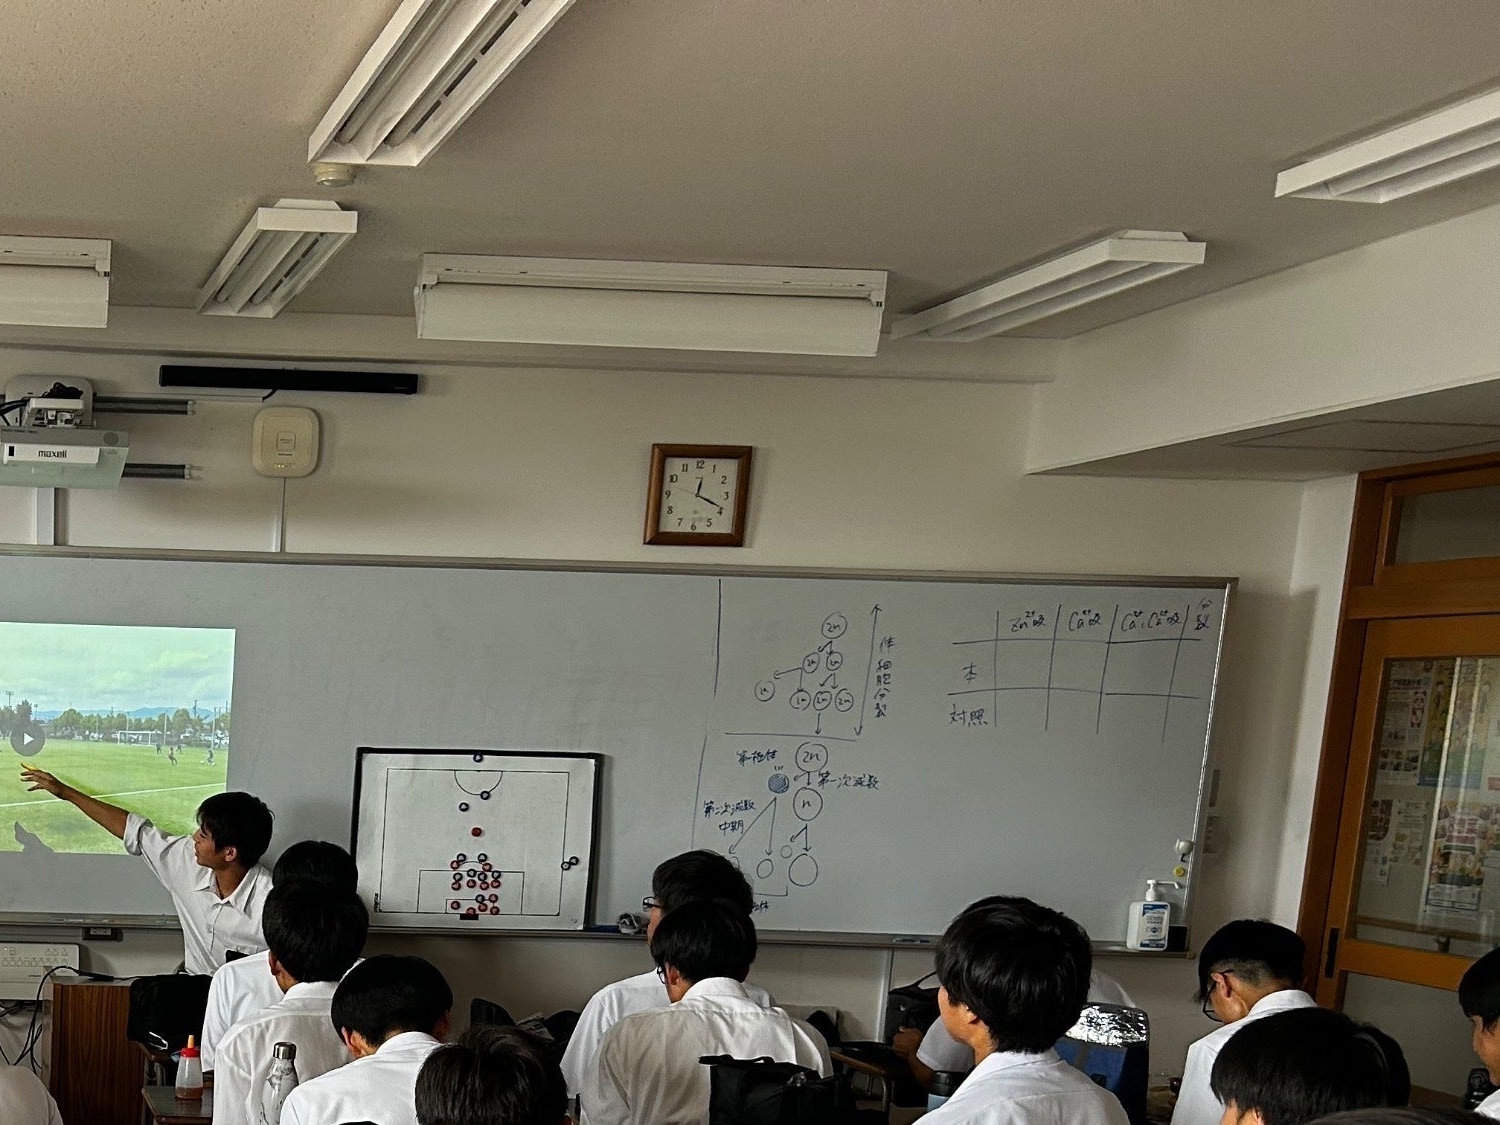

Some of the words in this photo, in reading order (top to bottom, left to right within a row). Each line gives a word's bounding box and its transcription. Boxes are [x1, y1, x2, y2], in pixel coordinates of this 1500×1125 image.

[38, 450, 67, 459] maxell
[682, 464, 688, 472] 11
[696, 460, 705, 469] 12
[712, 464, 716, 473] 1
[670, 474, 678, 483] 10
[721, 475, 727, 484] 2
[665, 490, 671, 499] 9
[724, 491, 730, 500] 3
[667, 506, 673, 515] 8
[717, 507, 724, 516] 4
[677, 518, 683, 527] 7
[691, 522, 697, 531] 6
[706, 518, 712, 527] 5
[826, 622, 841, 633] 2n
[949, 704, 988, 727] 対照
[802, 750, 821, 763] 2n
[802, 799, 812, 809] n
[718, 820, 744, 836] 中期
